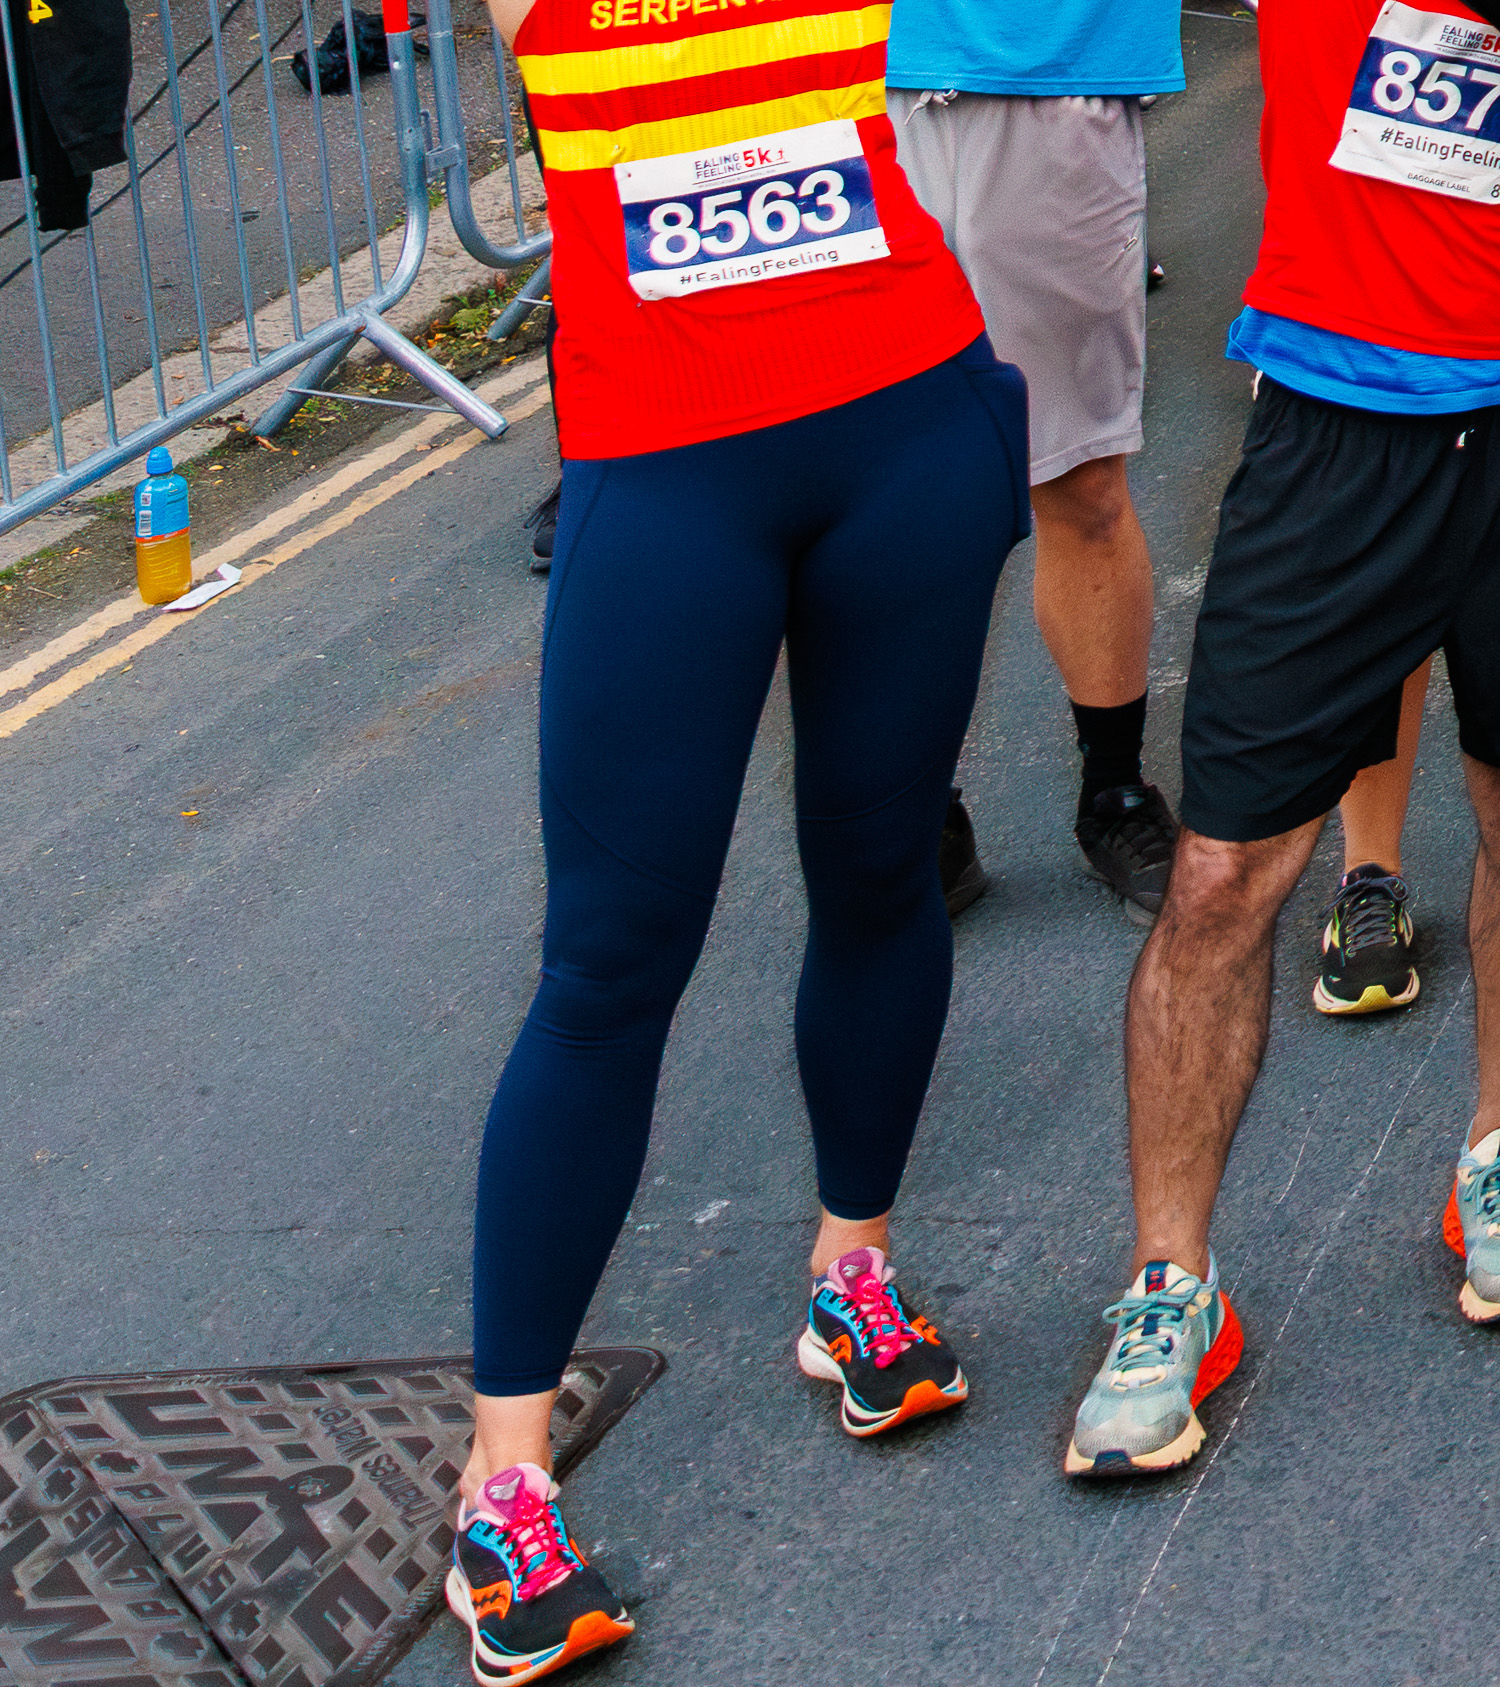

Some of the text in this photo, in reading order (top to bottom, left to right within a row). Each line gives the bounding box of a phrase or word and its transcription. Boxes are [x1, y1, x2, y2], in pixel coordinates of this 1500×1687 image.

[1439, 34, 1480, 49] FEELING
[1443, 25, 1484, 41] EALING
[694, 152, 741, 171] EALING
[742, 147, 773, 168] 5k
[696, 162, 743, 179] FEELING
[1407, 172, 1446, 187] BAGGAGE
[1447, 181, 1471, 193] LABEL
[649, 169, 851, 265] 8563
